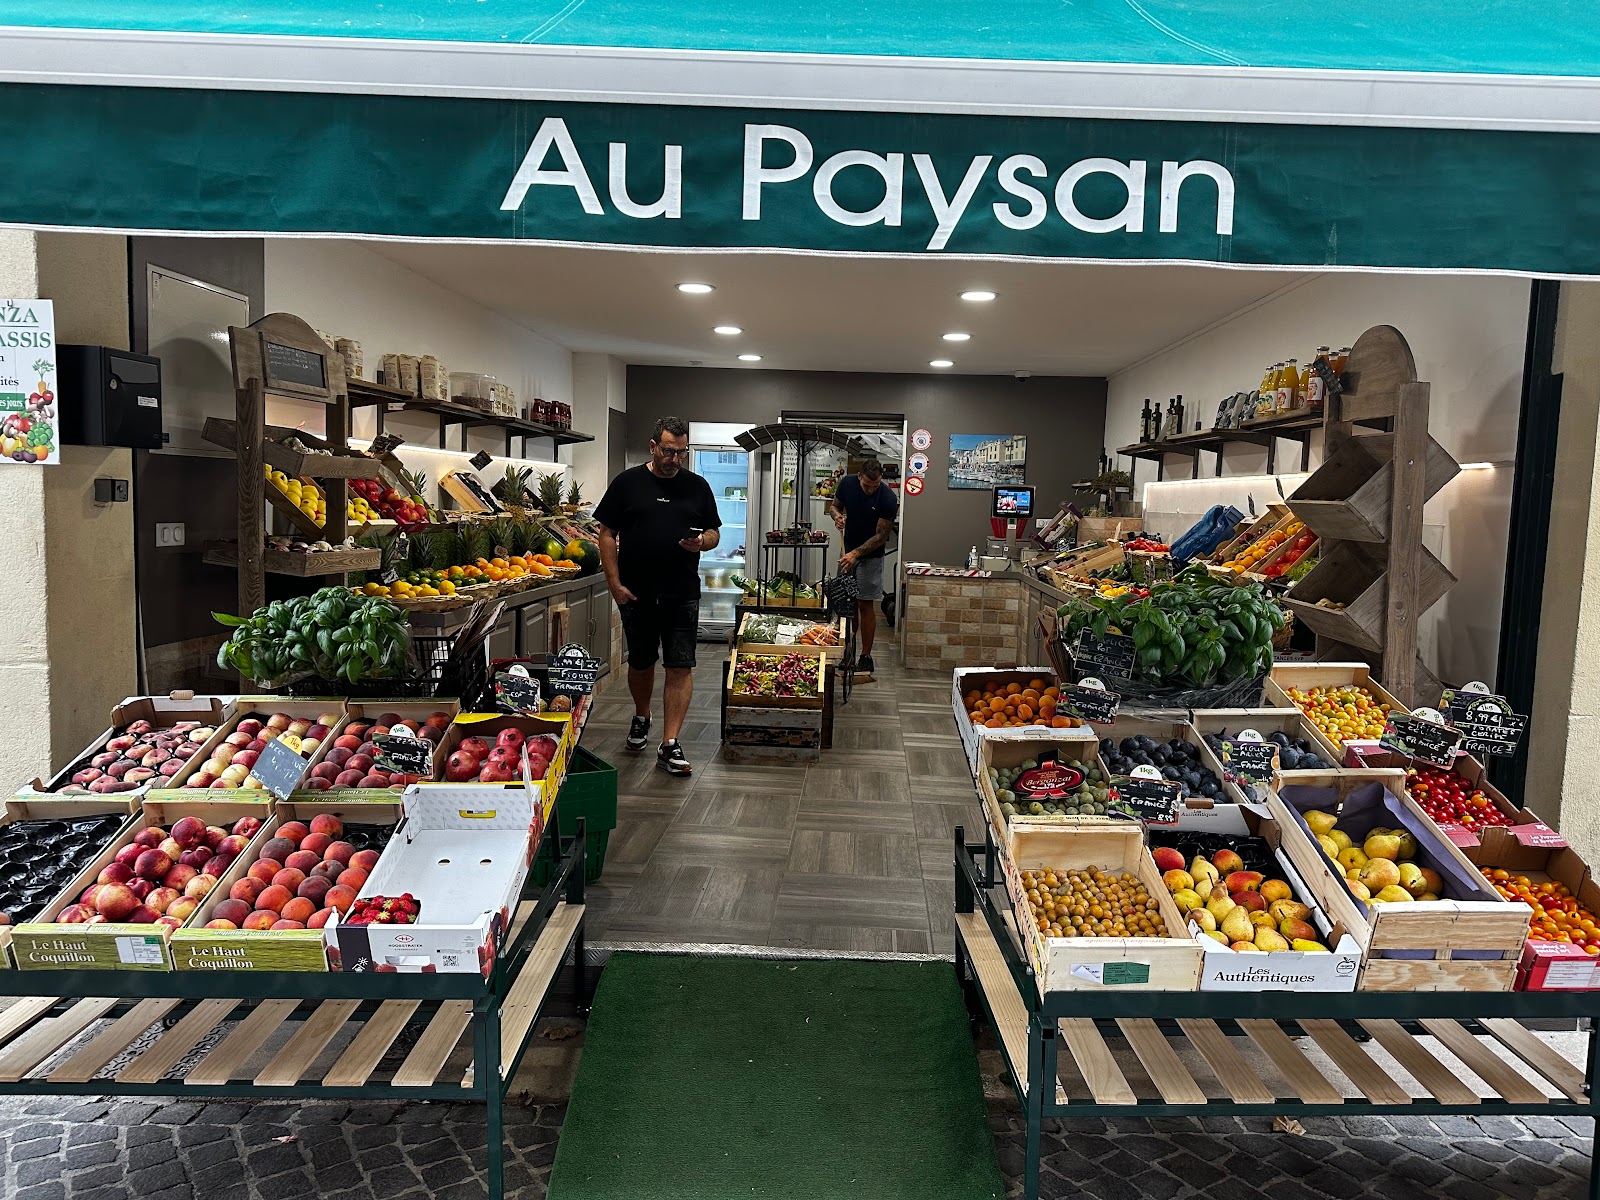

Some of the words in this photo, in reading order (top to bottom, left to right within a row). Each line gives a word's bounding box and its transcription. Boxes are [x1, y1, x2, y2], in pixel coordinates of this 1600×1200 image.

[500, 116, 682, 219] Au
[742, 123, 1235, 251] Paysan
[289, 737, 300, 750] 1kg
[1465, 740, 1504, 754] FRANCE
[1139, 767, 1154, 775] 1kg
[1240, 761, 1267, 771] FRANCE
[1130, 797, 1167, 809] FRANCE
[30, 939, 50, 950] Le
[53, 939, 87, 951] Haut
[190, 945, 209, 956] Le
[211, 946, 246, 957] Haut
[29, 951, 96, 965] Coquillon
[188, 957, 254, 970] Coquillon
[1248, 966, 1271, 976] Les
[1213, 971, 1316, 985] Authentiques
